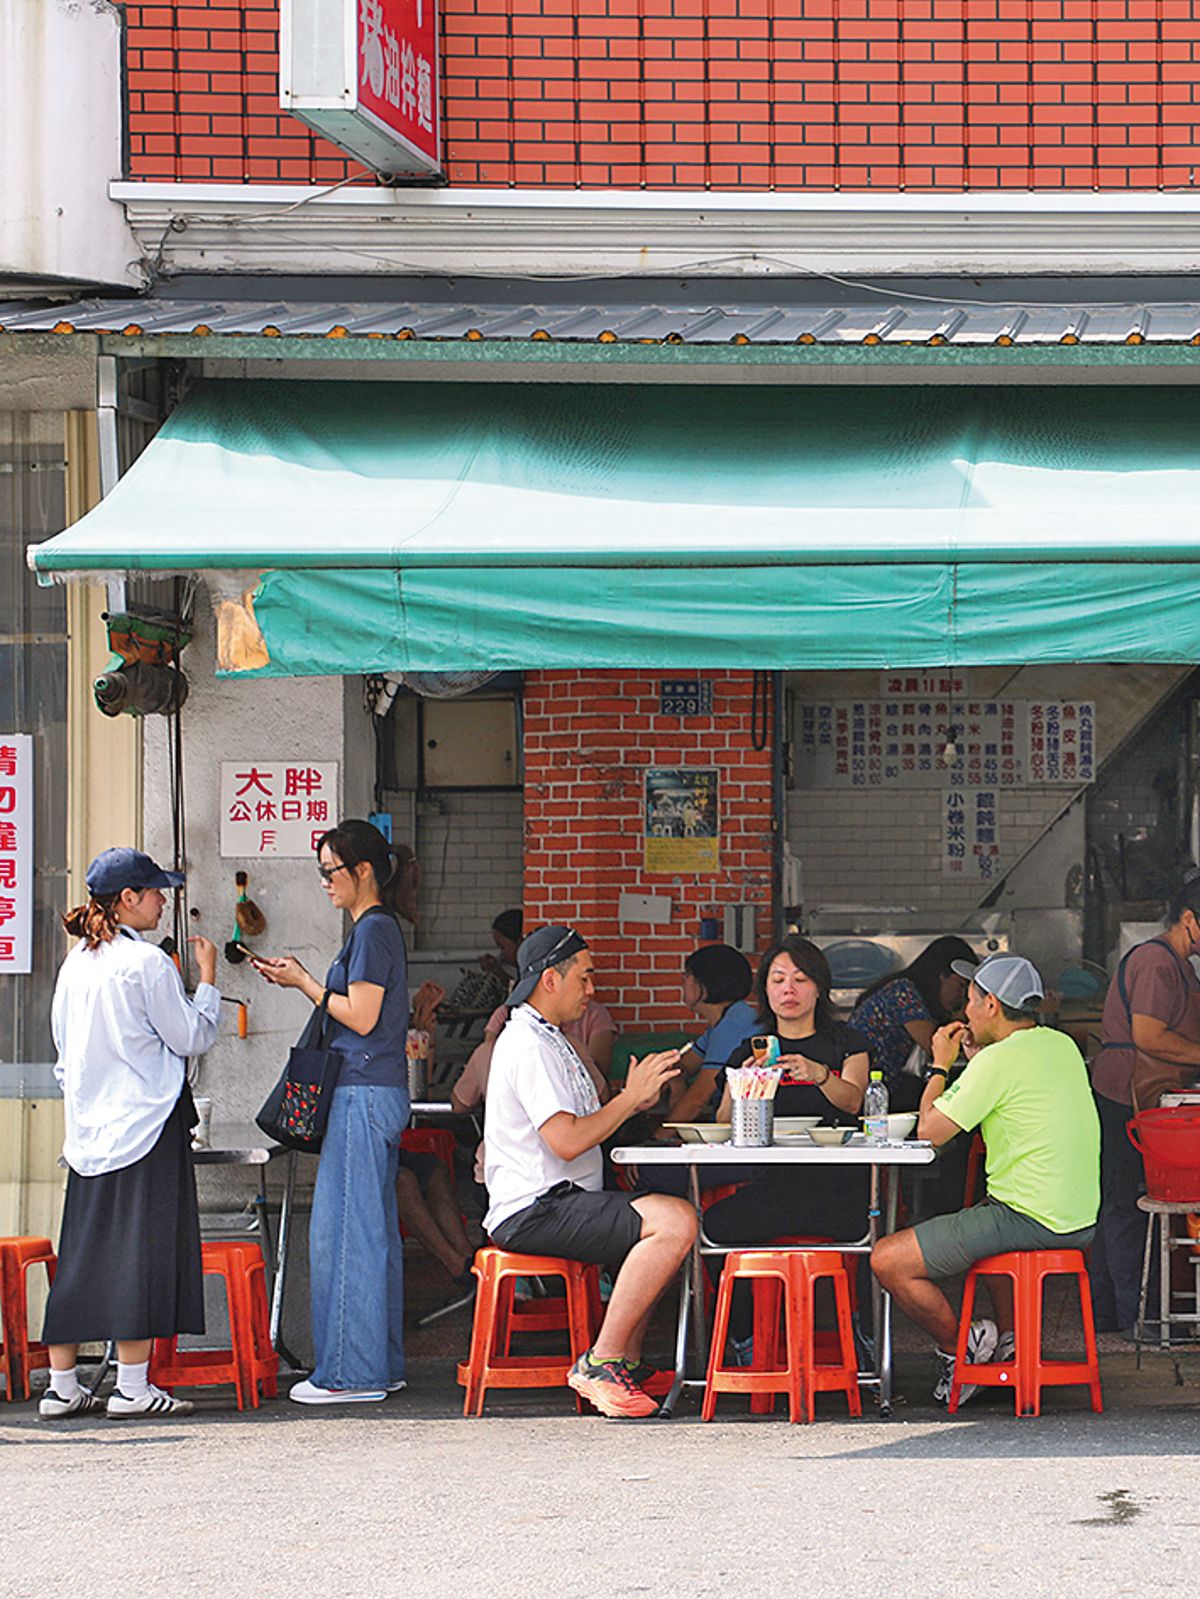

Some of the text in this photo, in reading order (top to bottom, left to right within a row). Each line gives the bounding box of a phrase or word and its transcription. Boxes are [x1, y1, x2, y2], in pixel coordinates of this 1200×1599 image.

[664, 700, 697, 713] 229
[902, 758, 916, 771] 35
[918, 758, 932, 771] 35
[984, 759, 998, 771] 45
[235, 767, 322, 796] 大胖
[951, 773, 965, 785] 55
[968, 773, 982, 785] 55
[984, 773, 998, 785] 55
[1001, 773, 1015, 785] 55
[229, 800, 328, 822] 公休日期
